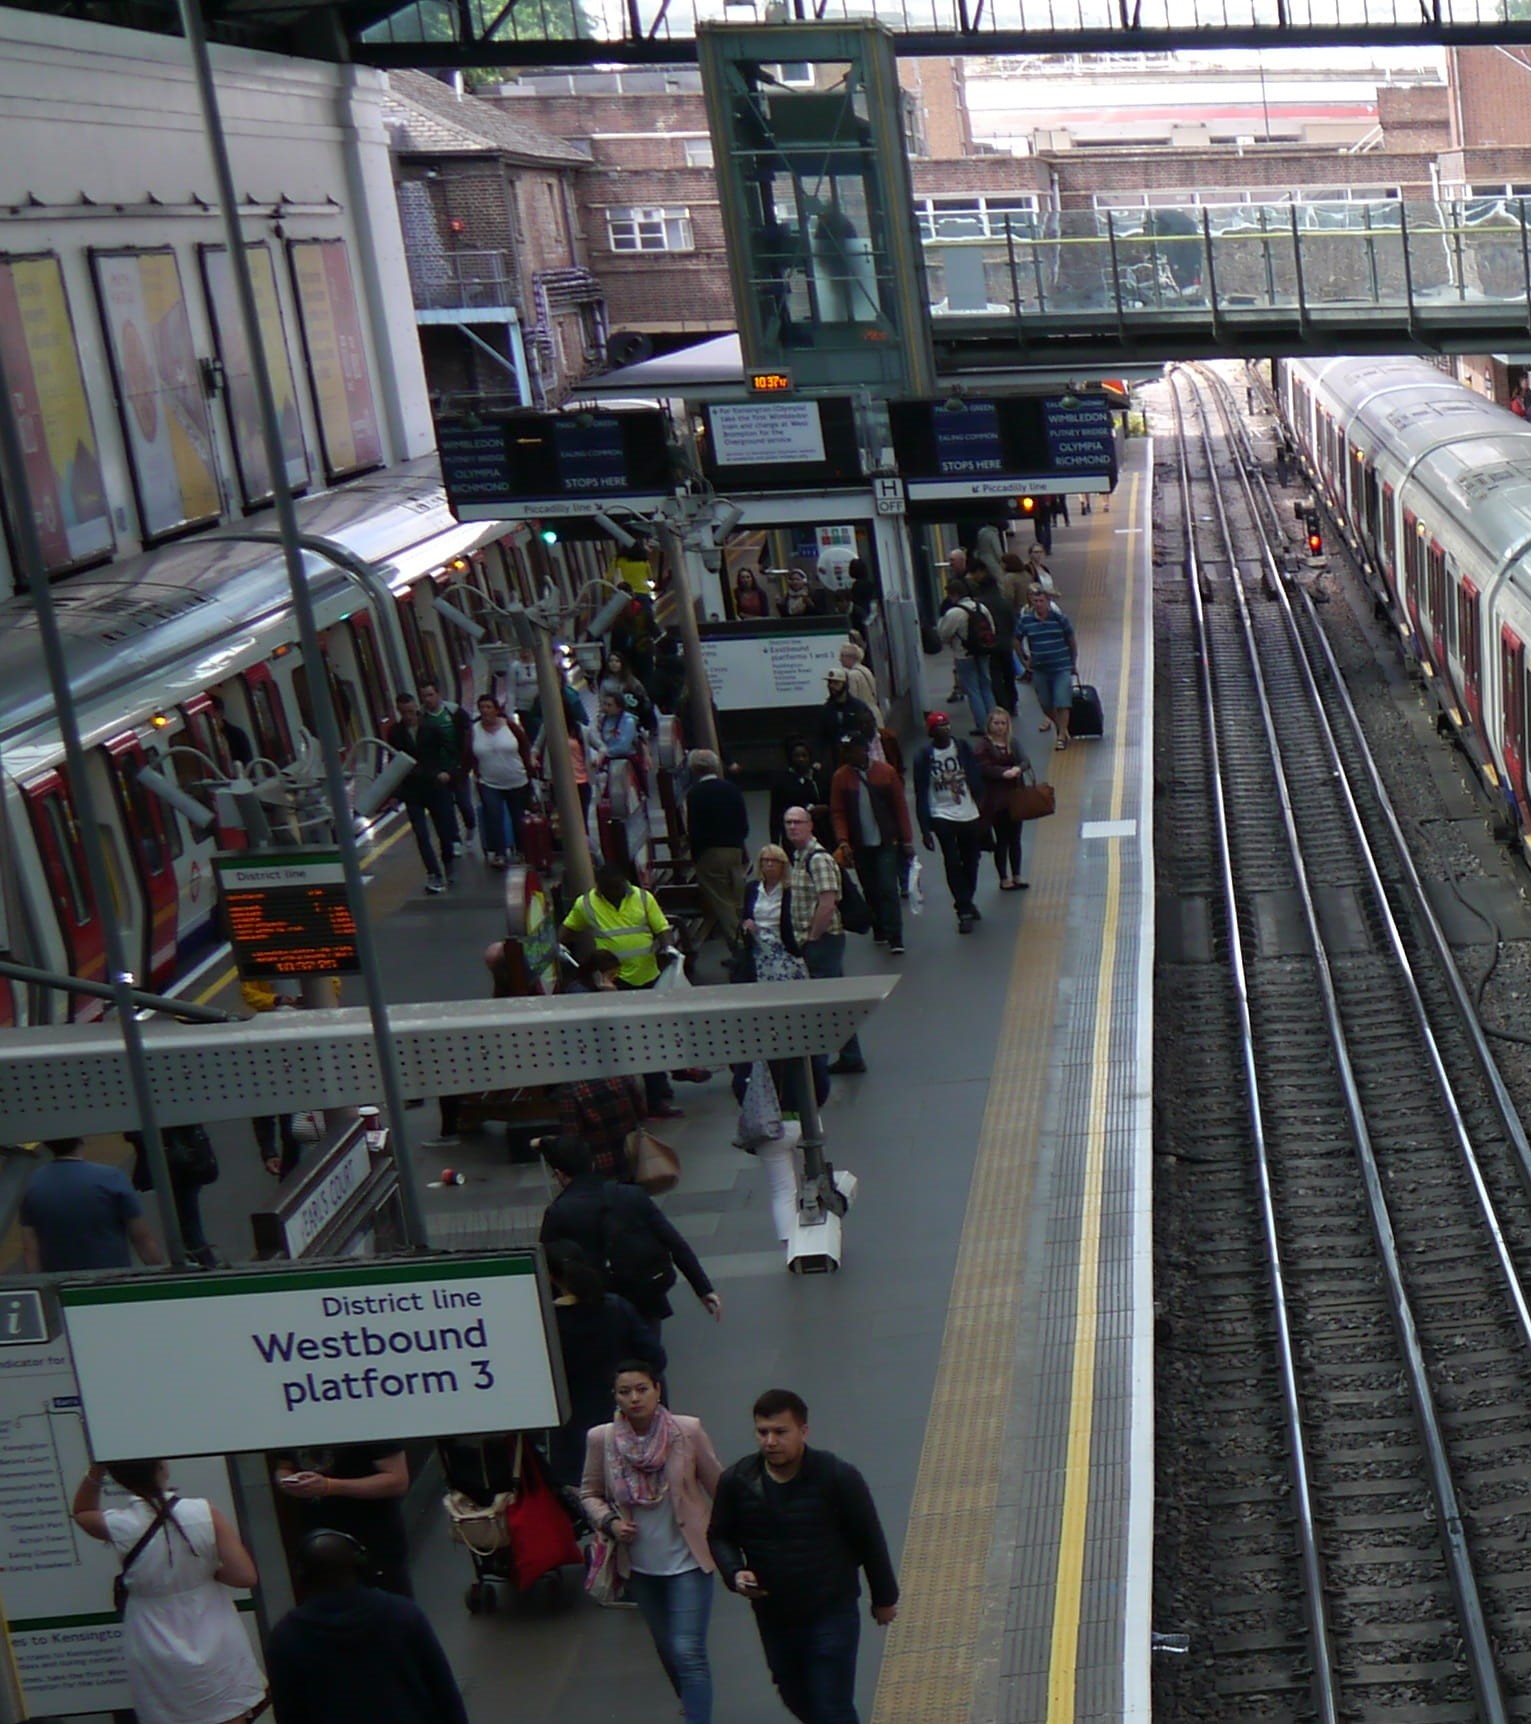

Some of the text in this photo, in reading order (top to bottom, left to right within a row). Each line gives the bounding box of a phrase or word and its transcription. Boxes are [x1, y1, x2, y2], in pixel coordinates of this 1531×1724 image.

[1047, 412, 1108, 424] WIMBLEDON
[1058, 441, 1104, 452] OLYMPIA
[942, 458, 1002, 472] STOPS HERE
[1055, 454, 1111, 466] RICHMOND
[565, 475, 629, 489] STOPS HERE
[881, 480, 897, 497] H
[982, 482, 1048, 494] Piccadilly line
[524, 502, 592, 515] Piccadilly line
[880, 501, 904, 512] OFF
[235, 869, 307, 882] District line
[322, 1289, 482, 1317] District line
[252, 1318, 488, 1363] Westbound
[283, 1359, 495, 1412] platform 3
[31, 1636, 48, 1646] to
